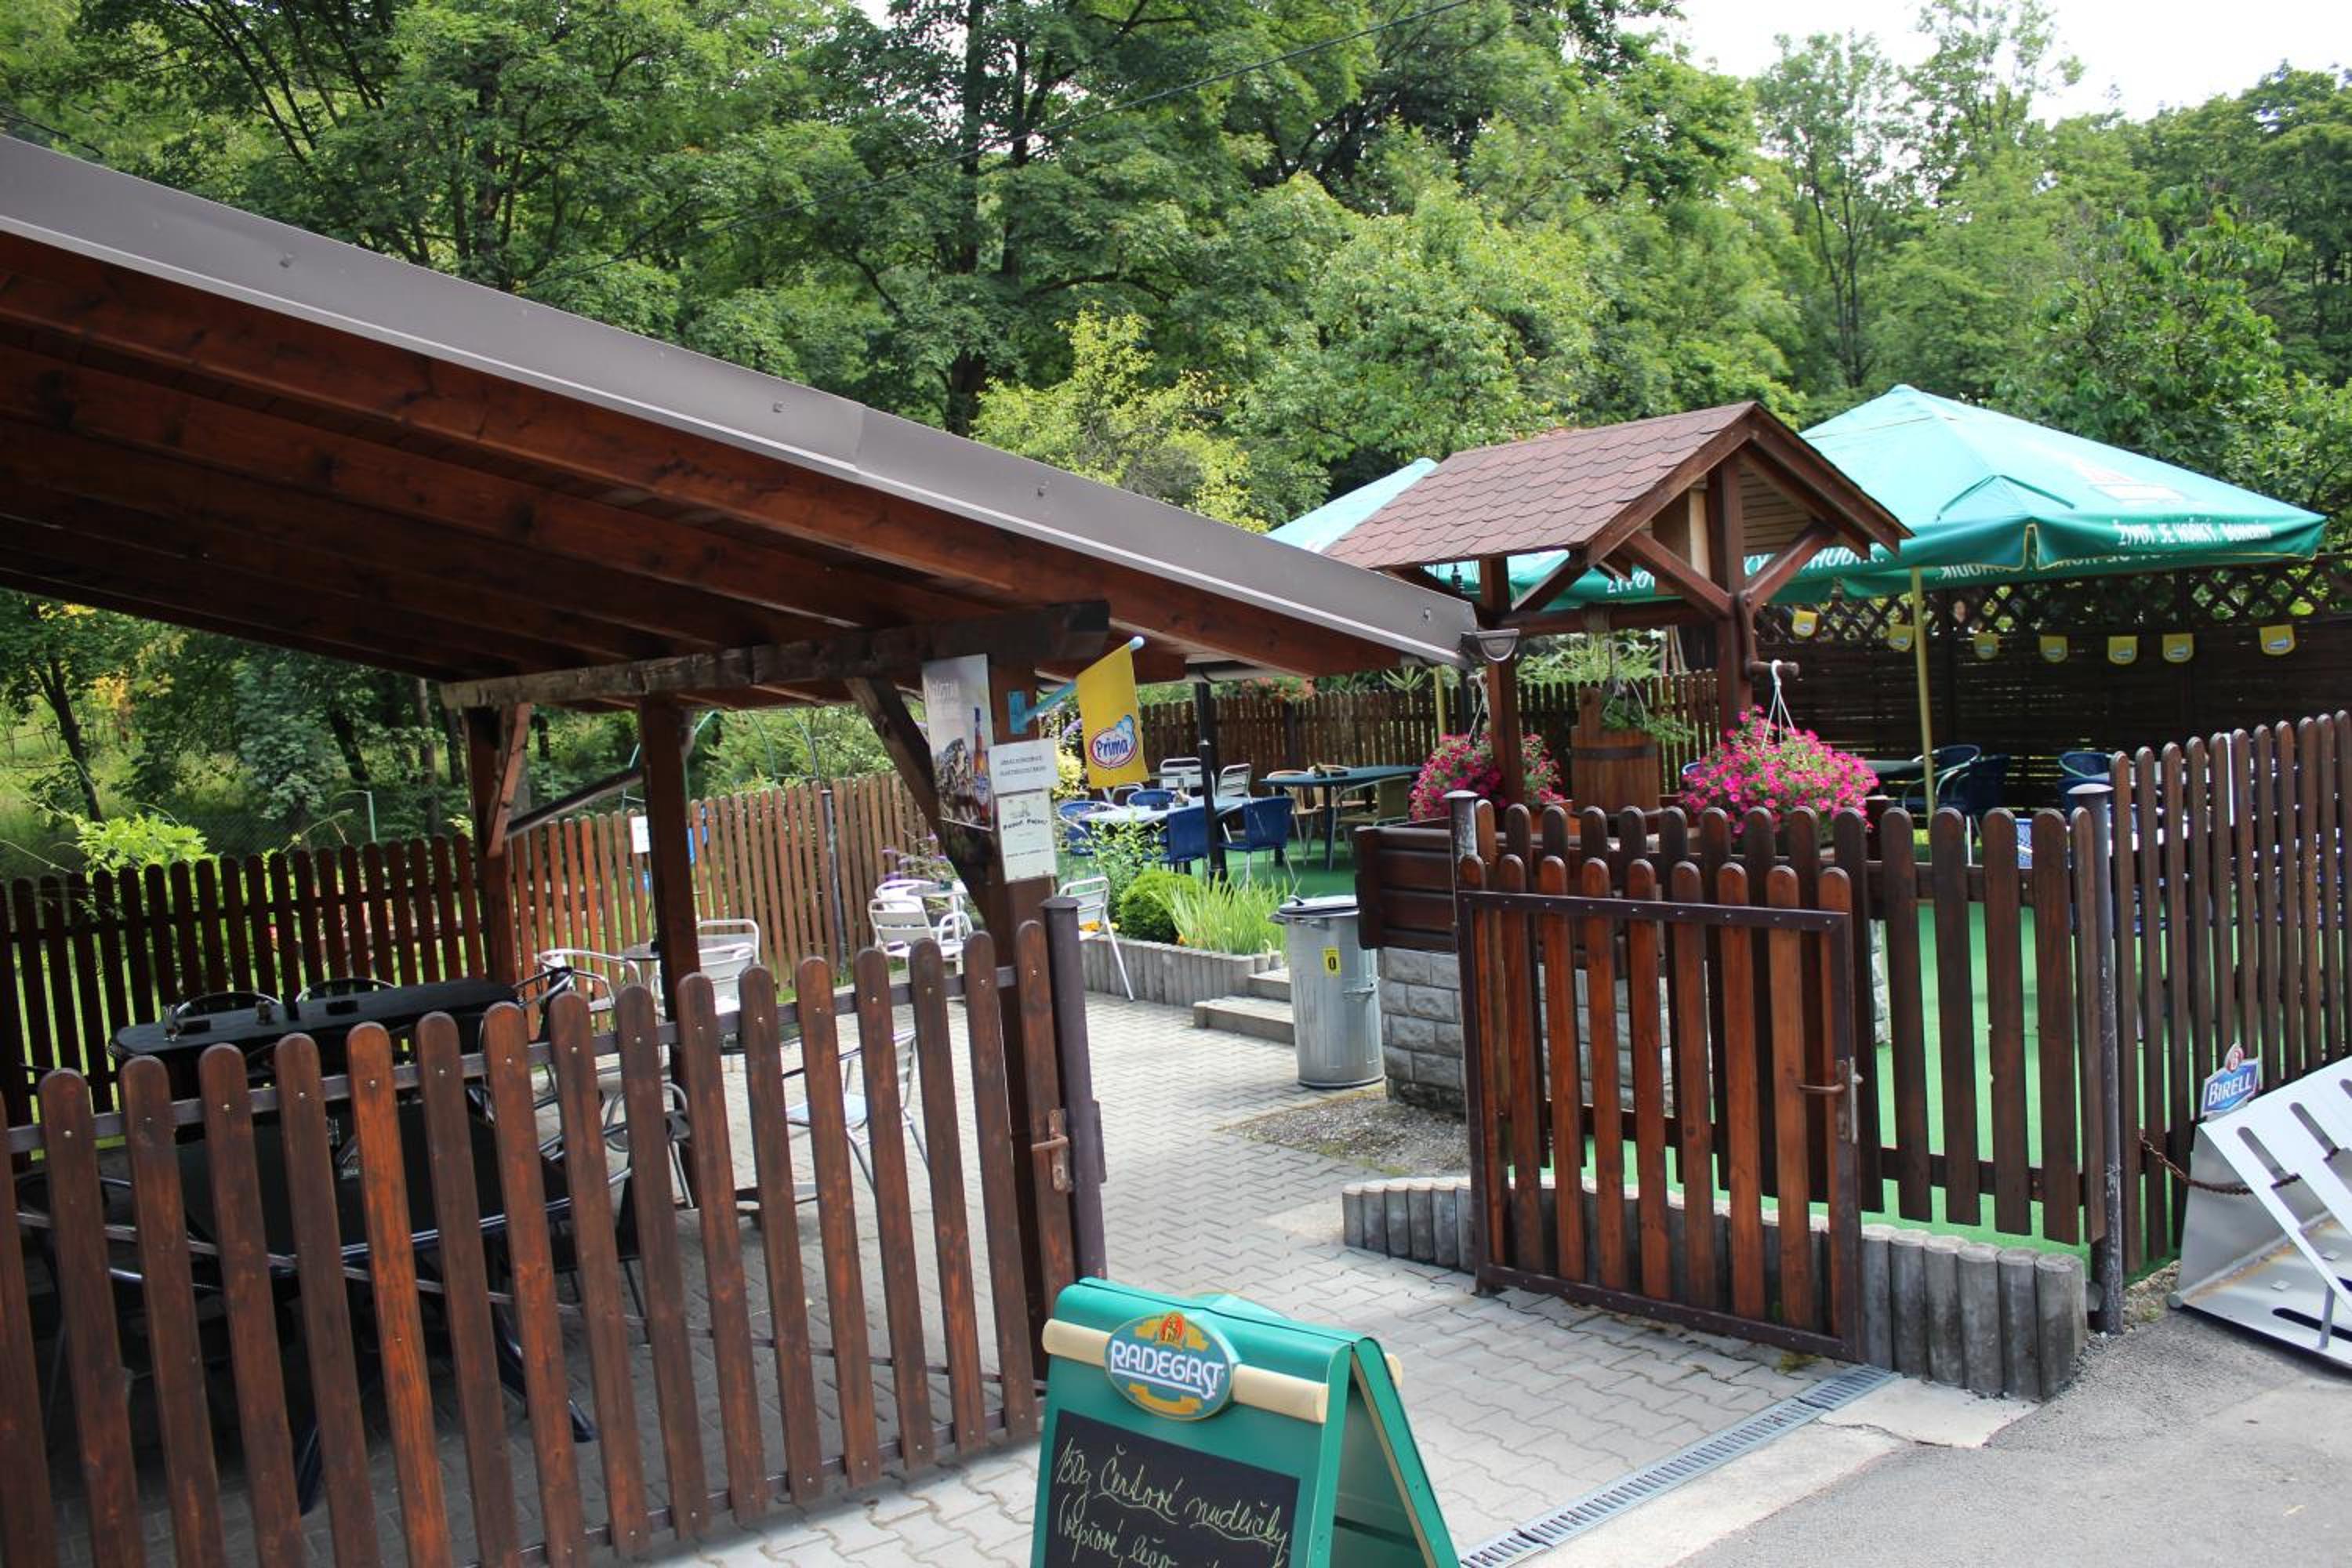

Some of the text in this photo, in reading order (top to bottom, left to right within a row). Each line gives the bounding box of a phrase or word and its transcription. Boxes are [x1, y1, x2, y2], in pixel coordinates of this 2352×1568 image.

[1096, 738, 1129, 758] Prima
[2207, 1072, 2252, 1106] BIRELL
[1110, 1339, 1225, 1399] RADEGAST
